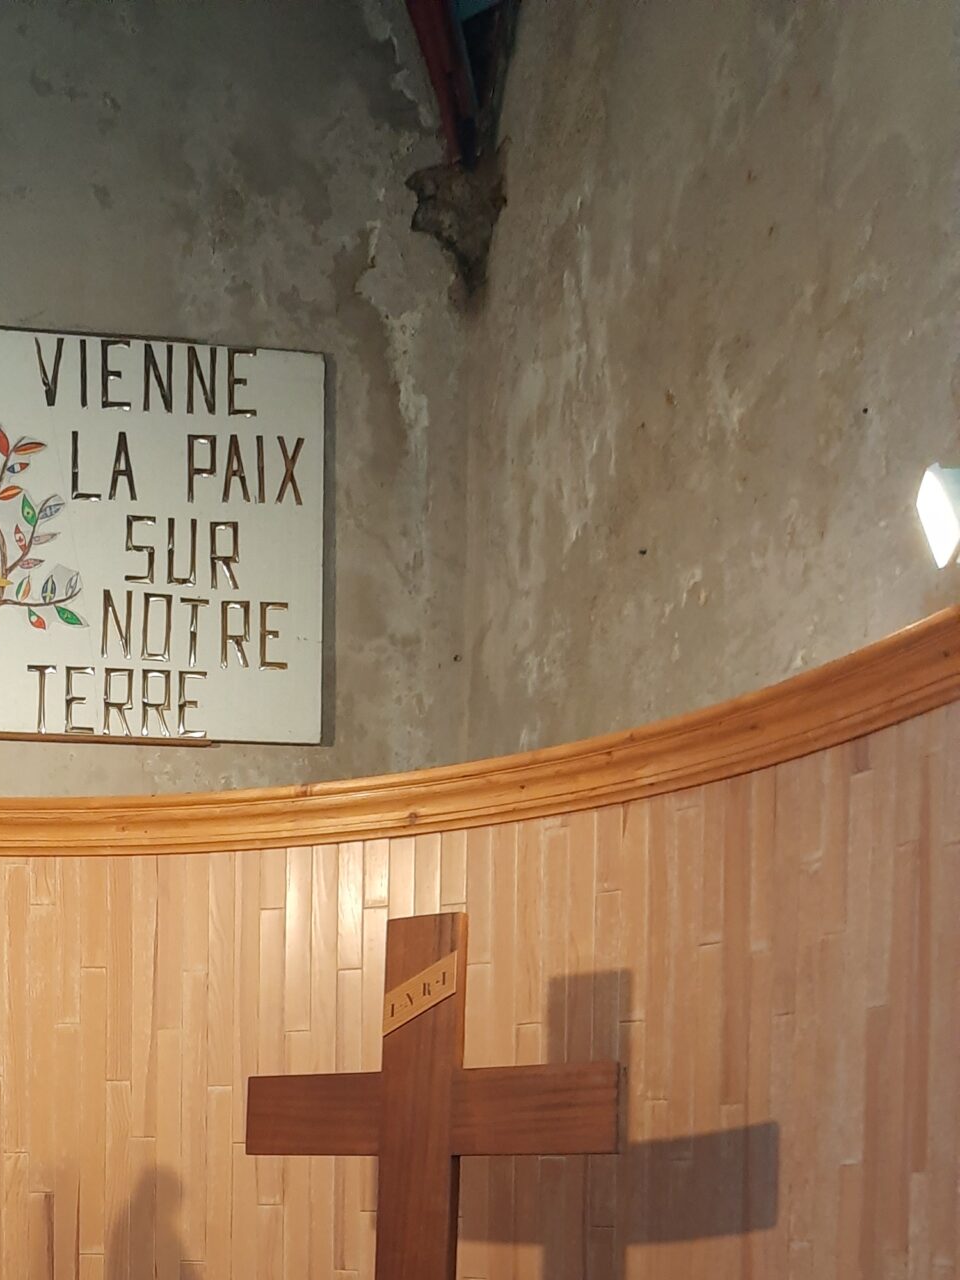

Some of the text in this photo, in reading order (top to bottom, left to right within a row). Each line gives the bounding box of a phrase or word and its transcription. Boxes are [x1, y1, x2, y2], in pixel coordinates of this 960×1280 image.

[34, 337, 257, 417] VIENNE
[71, 430, 305, 506] LA PAIX
[124, 514, 240, 591] SUR
[100, 588, 289, 670] NOTRE
[27, 664, 208, 739] TERRE
